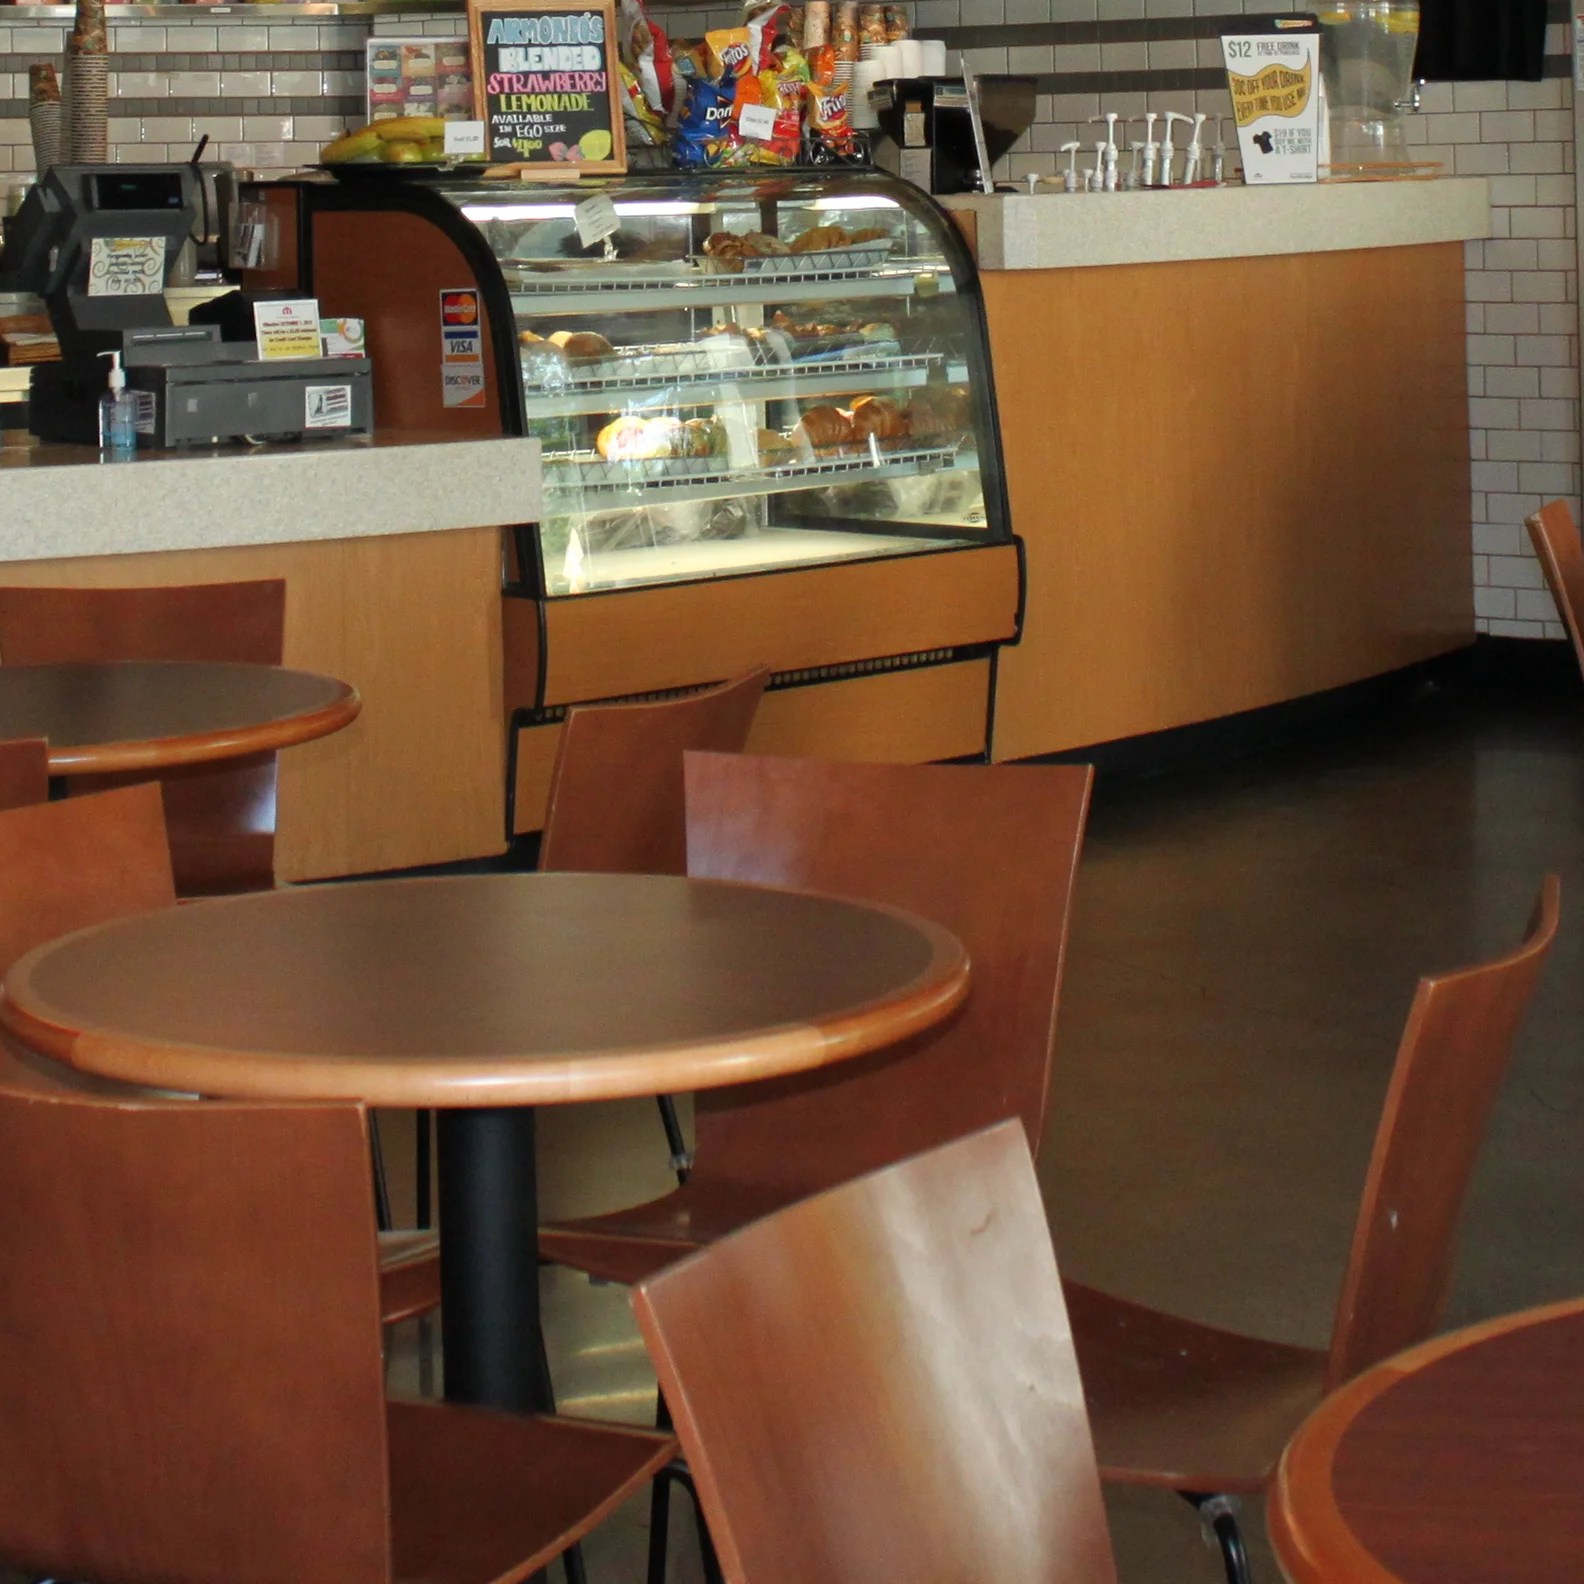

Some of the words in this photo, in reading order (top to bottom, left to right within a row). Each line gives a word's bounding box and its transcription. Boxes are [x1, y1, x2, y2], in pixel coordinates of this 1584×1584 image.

[722, 45, 748, 64] Fritos
[1229, 41, 1251, 57] $12
[1257, 42, 1275, 50] FREE
[498, 46, 601, 72] BLENDED
[488, 72, 606, 94] STRAWBERRY
[500, 93, 594, 112] LEMONADE
[492, 114, 552, 124] AVAILABLE
[516, 125, 542, 138] EGO
[544, 124, 566, 132] SIZE
[1297, 129, 1311, 137] YOU
[451, 341, 472, 353] VISA
[445, 376, 480, 385] DISCOVER
